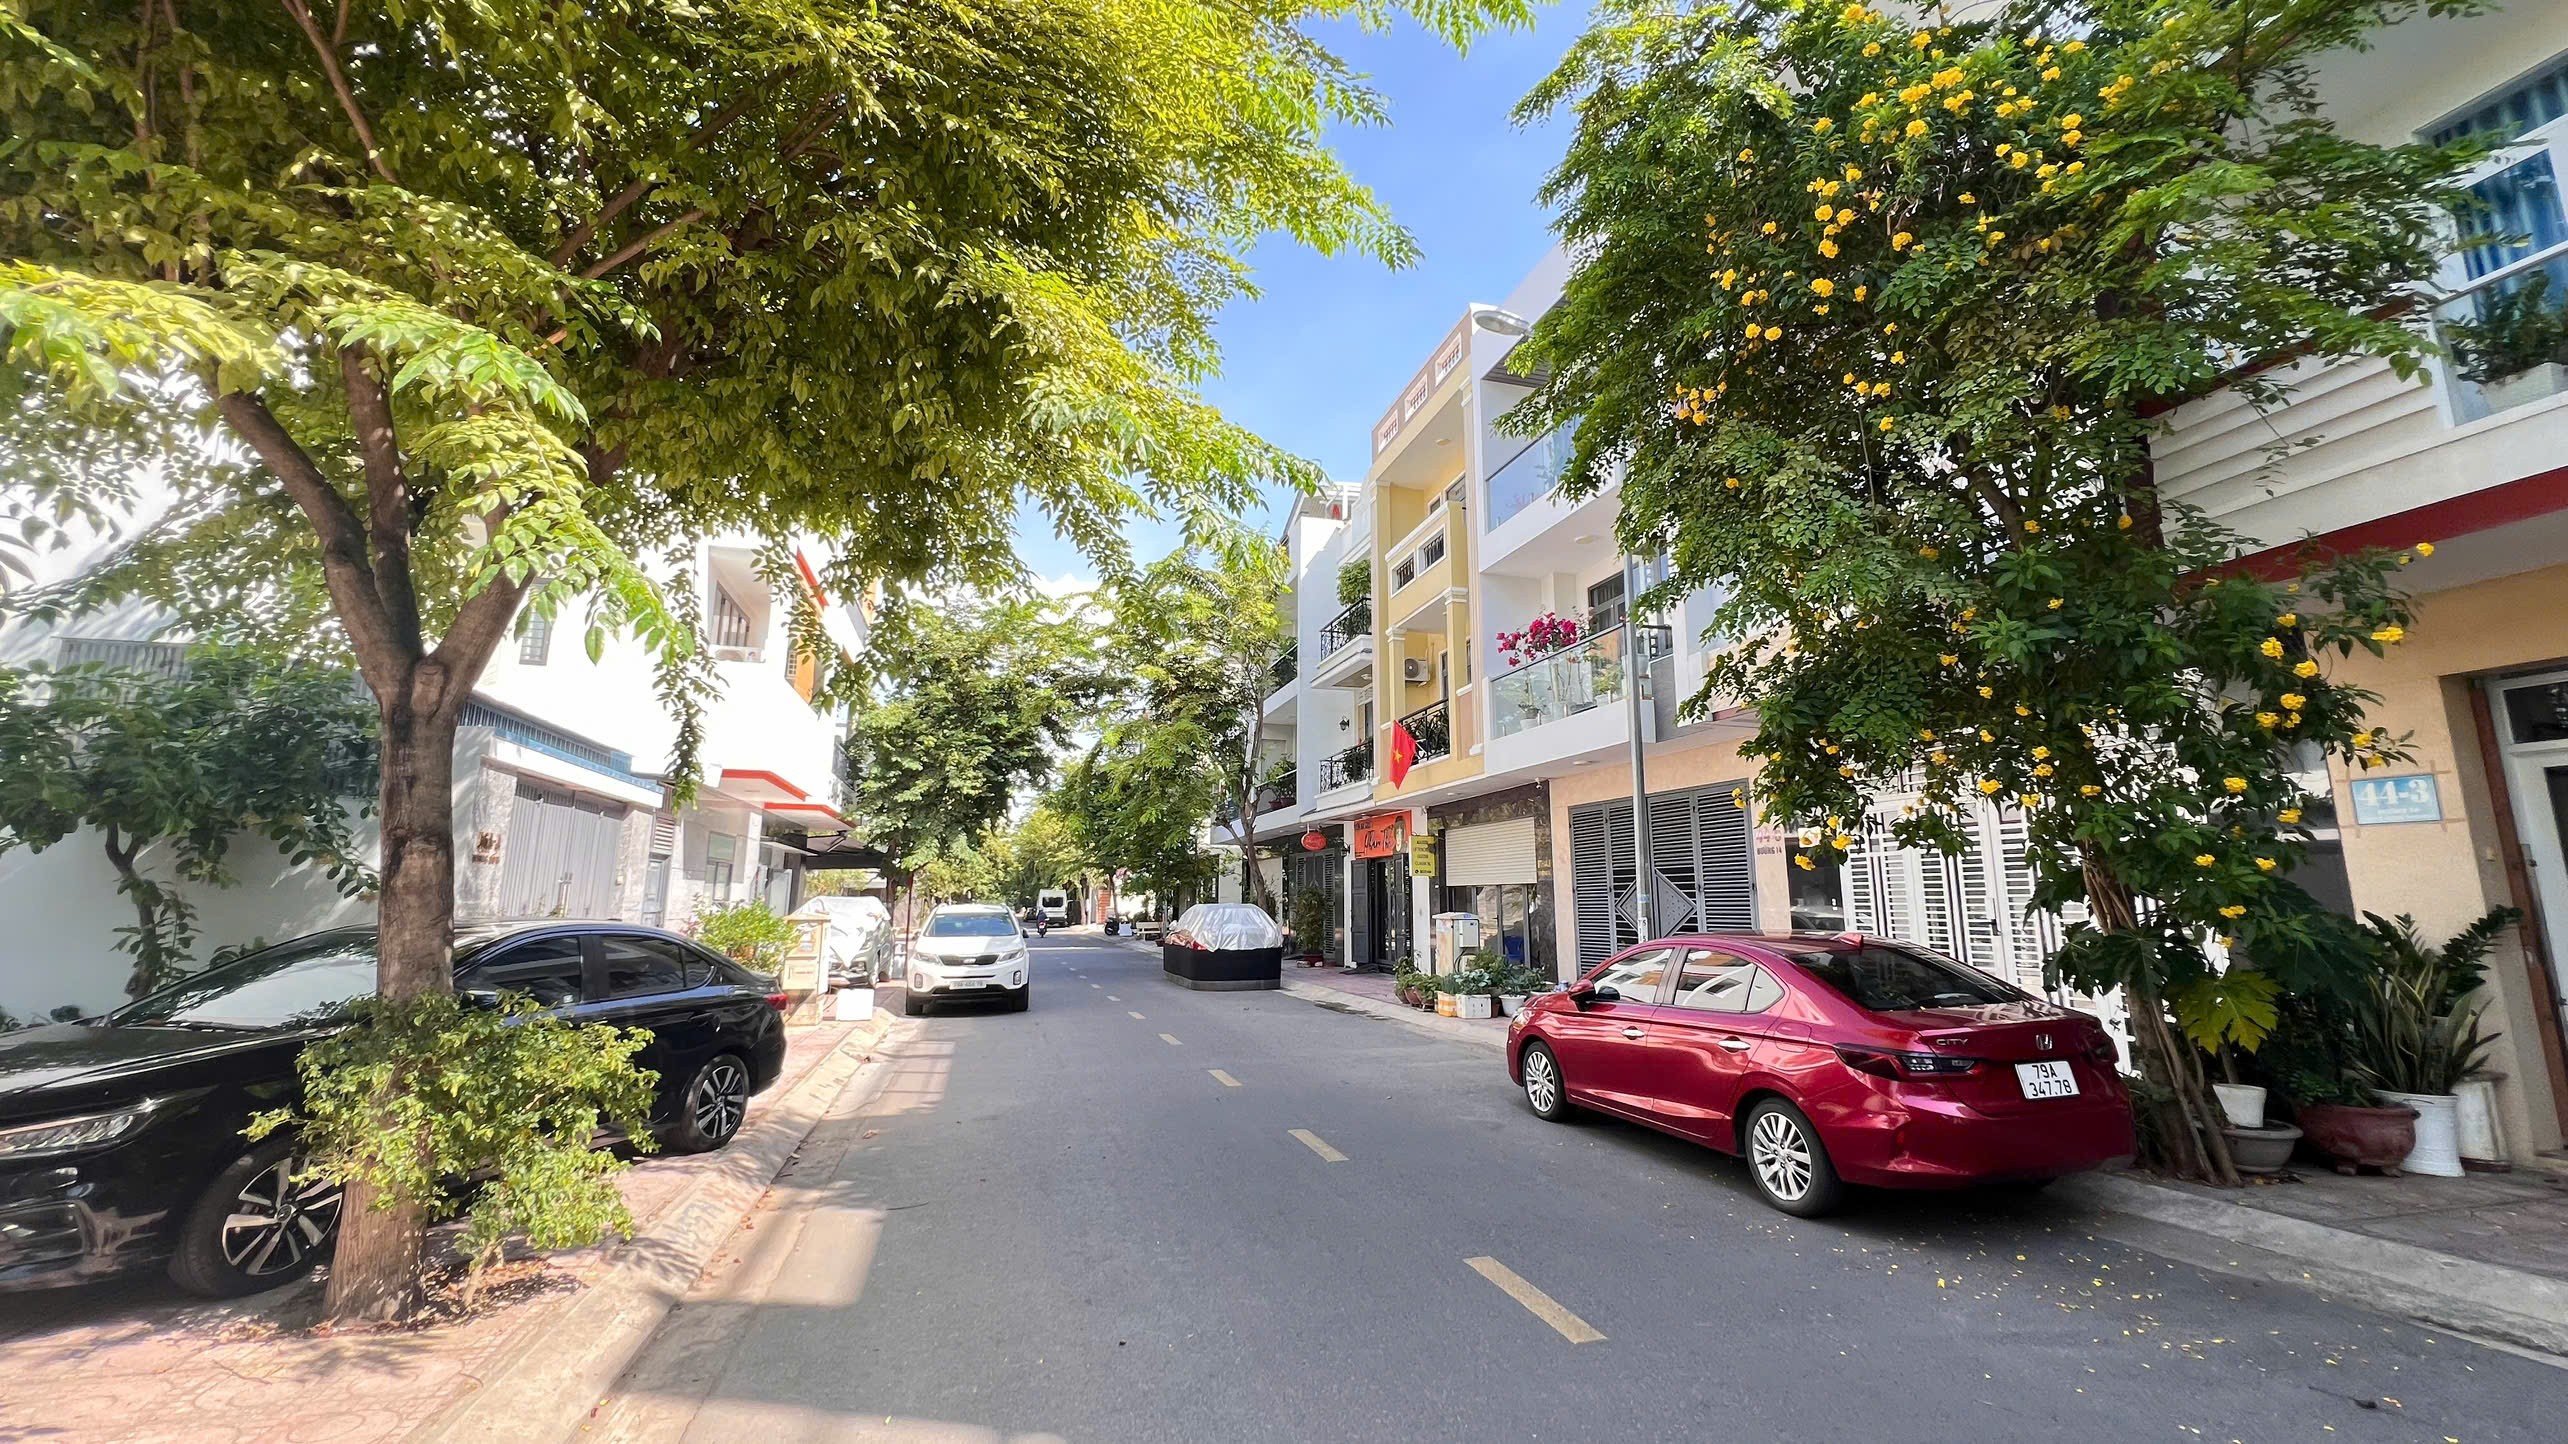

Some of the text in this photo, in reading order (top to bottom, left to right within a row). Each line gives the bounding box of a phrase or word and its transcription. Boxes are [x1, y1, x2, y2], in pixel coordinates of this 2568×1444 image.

[2358, 780, 2430, 806] 44-3
[1936, 1038, 1969, 1046] CITY
[2031, 1064, 2058, 1079] 79A
[2029, 1079, 2073, 1097] 347.78
